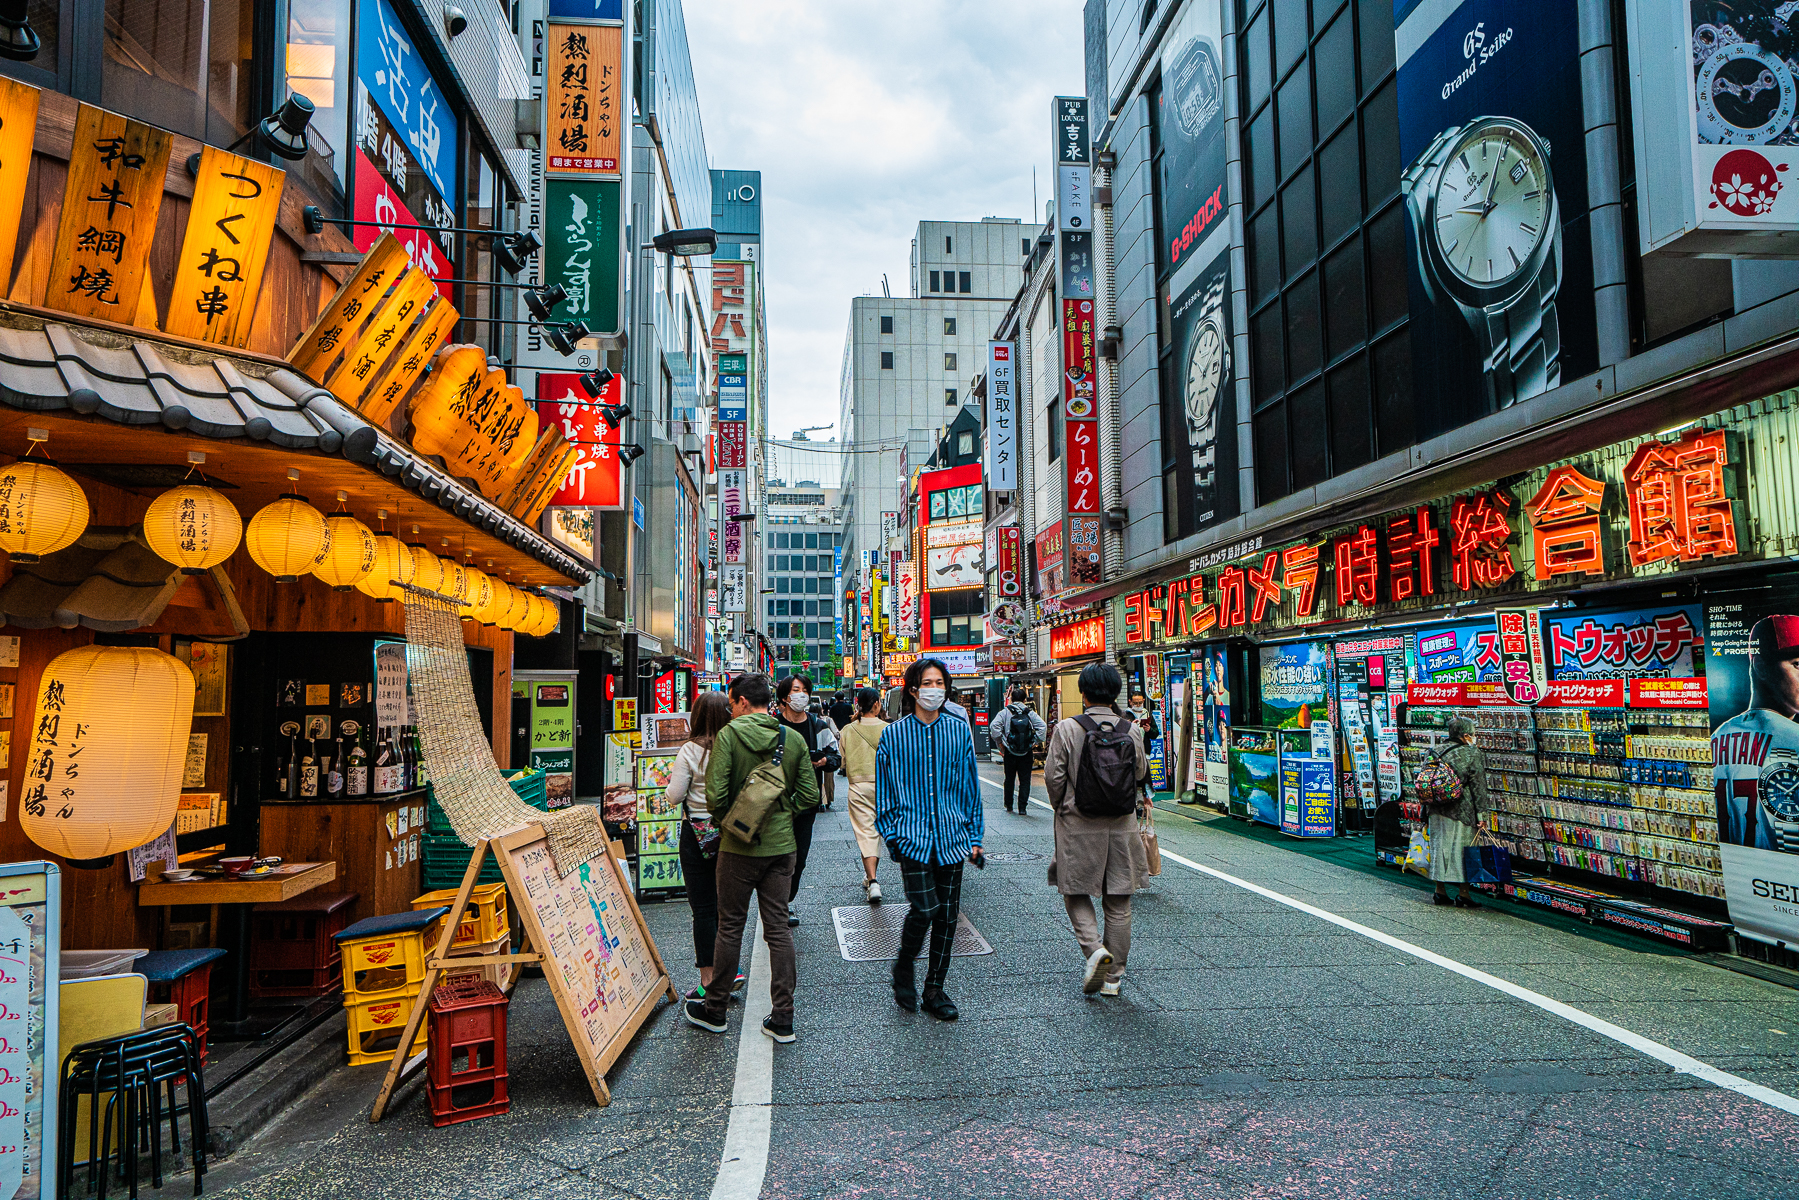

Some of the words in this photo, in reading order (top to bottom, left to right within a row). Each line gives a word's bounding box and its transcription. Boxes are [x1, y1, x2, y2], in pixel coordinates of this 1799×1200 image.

[1441, 59, 1478, 100] Grand
[1479, 26, 1514, 66] Seiko
[597, 64, 613, 138] ドンちゃん
[1065, 123, 1083, 161] 吉永
[552, 157, 614, 169] 朝まで営業中
[1072, 177, 1081, 207] FAKE
[1463, 182, 1478, 202] Grand
[1475, 171, 1490, 187] Seiko
[1171, 183, 1223, 264] G-SHOCK
[195, 171, 262, 325] つくね串
[1065, 307, 1078, 333] 元祖
[1080, 318, 1094, 374] 麻婆豆腐
[724, 376, 742, 384] CBR
[994, 367, 1009, 377] 6F
[726, 410, 739, 419] 5F
[994, 380, 1011, 482] 買取センター
[1073, 423, 1094, 510] らーめん
[16, 492, 27, 536] ドンちゃん
[201, 512, 210, 552] ドンちゃん
[900, 573, 914, 622] ラーメン
[1708, 604, 1743, 613] SHO-TIME
[1709, 613, 1729, 621] それは、
[1421, 636, 1455, 654] 健康管理に
[1529, 613, 1544, 681] 店内は天井照明による
[1551, 613, 1693, 667] トウォッチ
[1501, 613, 1539, 702] 除菌で安心
[1724, 647, 1761, 656] PROSPEX
[1369, 667, 1383, 676] cca
[1428, 654, 1461, 670] スポーツに
[1264, 665, 1322, 685] 防水性能の強い
[1434, 671, 1475, 684] アウトドアに
[1413, 686, 1459, 698] デジタルウォッチ
[1545, 685, 1614, 698] アナログウォッチ
[616, 700, 635, 709] 警告
[535, 729, 571, 742] かど新
[55, 722, 90, 820] ドンちゃん
[1304, 798, 1332, 807] ご自由に
[1308, 806, 1329, 815] お使い
[1305, 815, 1332, 824] ください
[1714, 778, 1758, 848] 17
[1551, 899, 1587, 916] ヨドバシカメラ
[1773, 904, 1799, 916] SINCE
